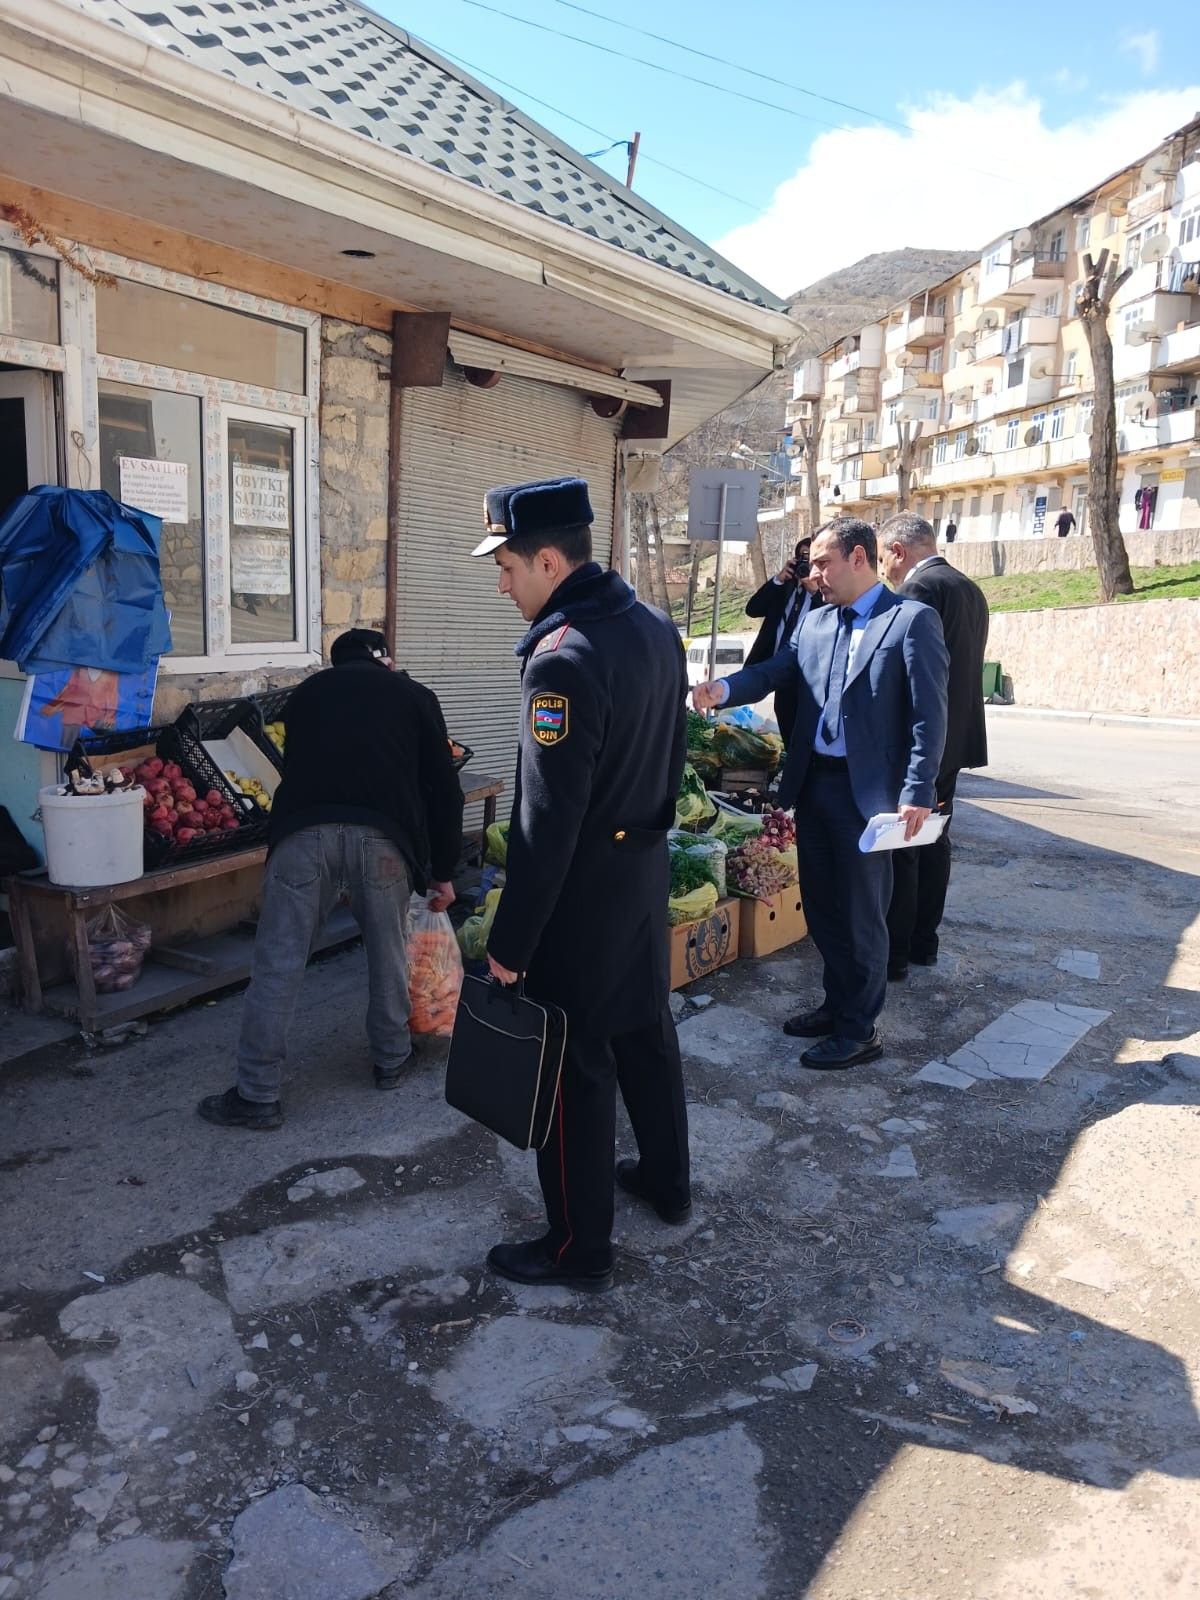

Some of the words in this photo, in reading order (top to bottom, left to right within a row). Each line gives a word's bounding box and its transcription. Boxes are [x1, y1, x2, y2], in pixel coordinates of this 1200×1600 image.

[121, 459, 138, 470] EV
[235, 474, 285, 492] OBYEKT
[234, 490, 286, 509] SATILIR
